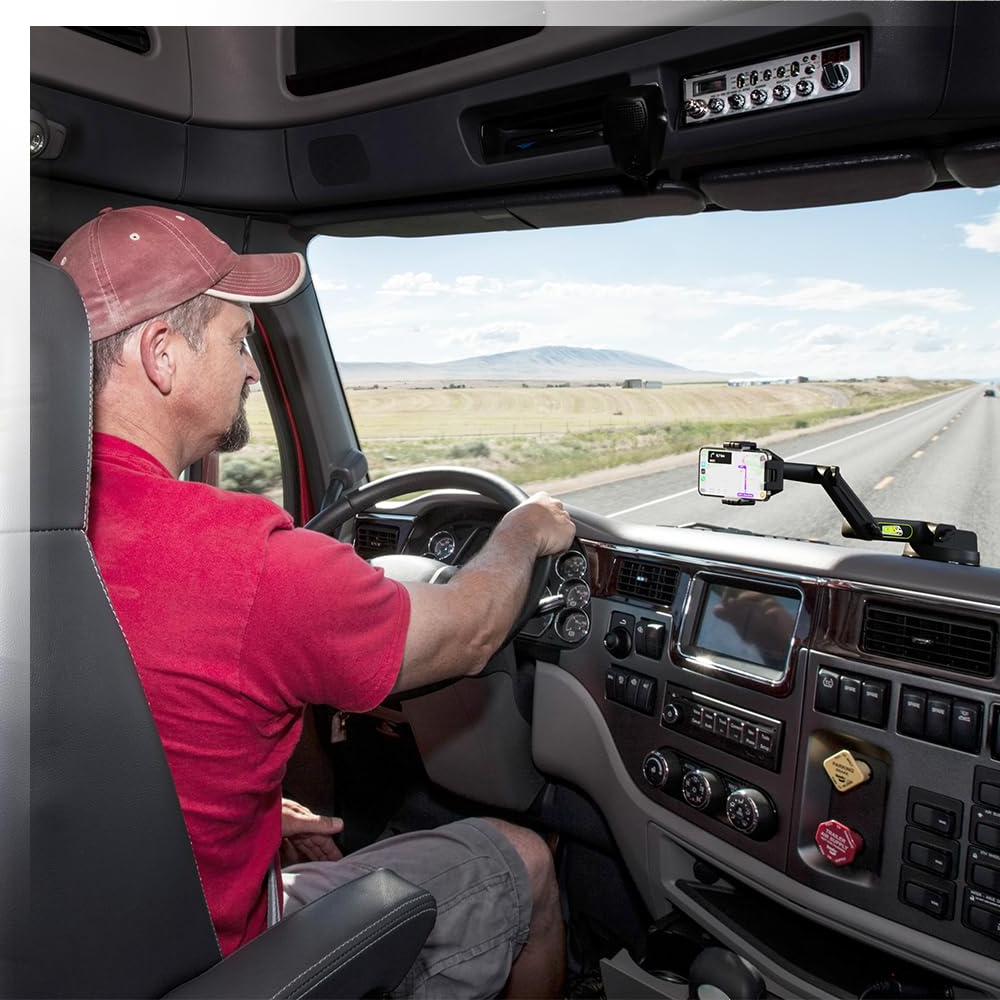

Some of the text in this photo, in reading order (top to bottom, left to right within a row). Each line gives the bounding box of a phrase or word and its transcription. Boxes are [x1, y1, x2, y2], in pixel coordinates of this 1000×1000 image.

[832, 761, 855, 773] PARKING
[820, 831, 830, 839] AIR
[829, 836, 849, 851] SUPPLY
[825, 828, 846, 843] TRAILER
